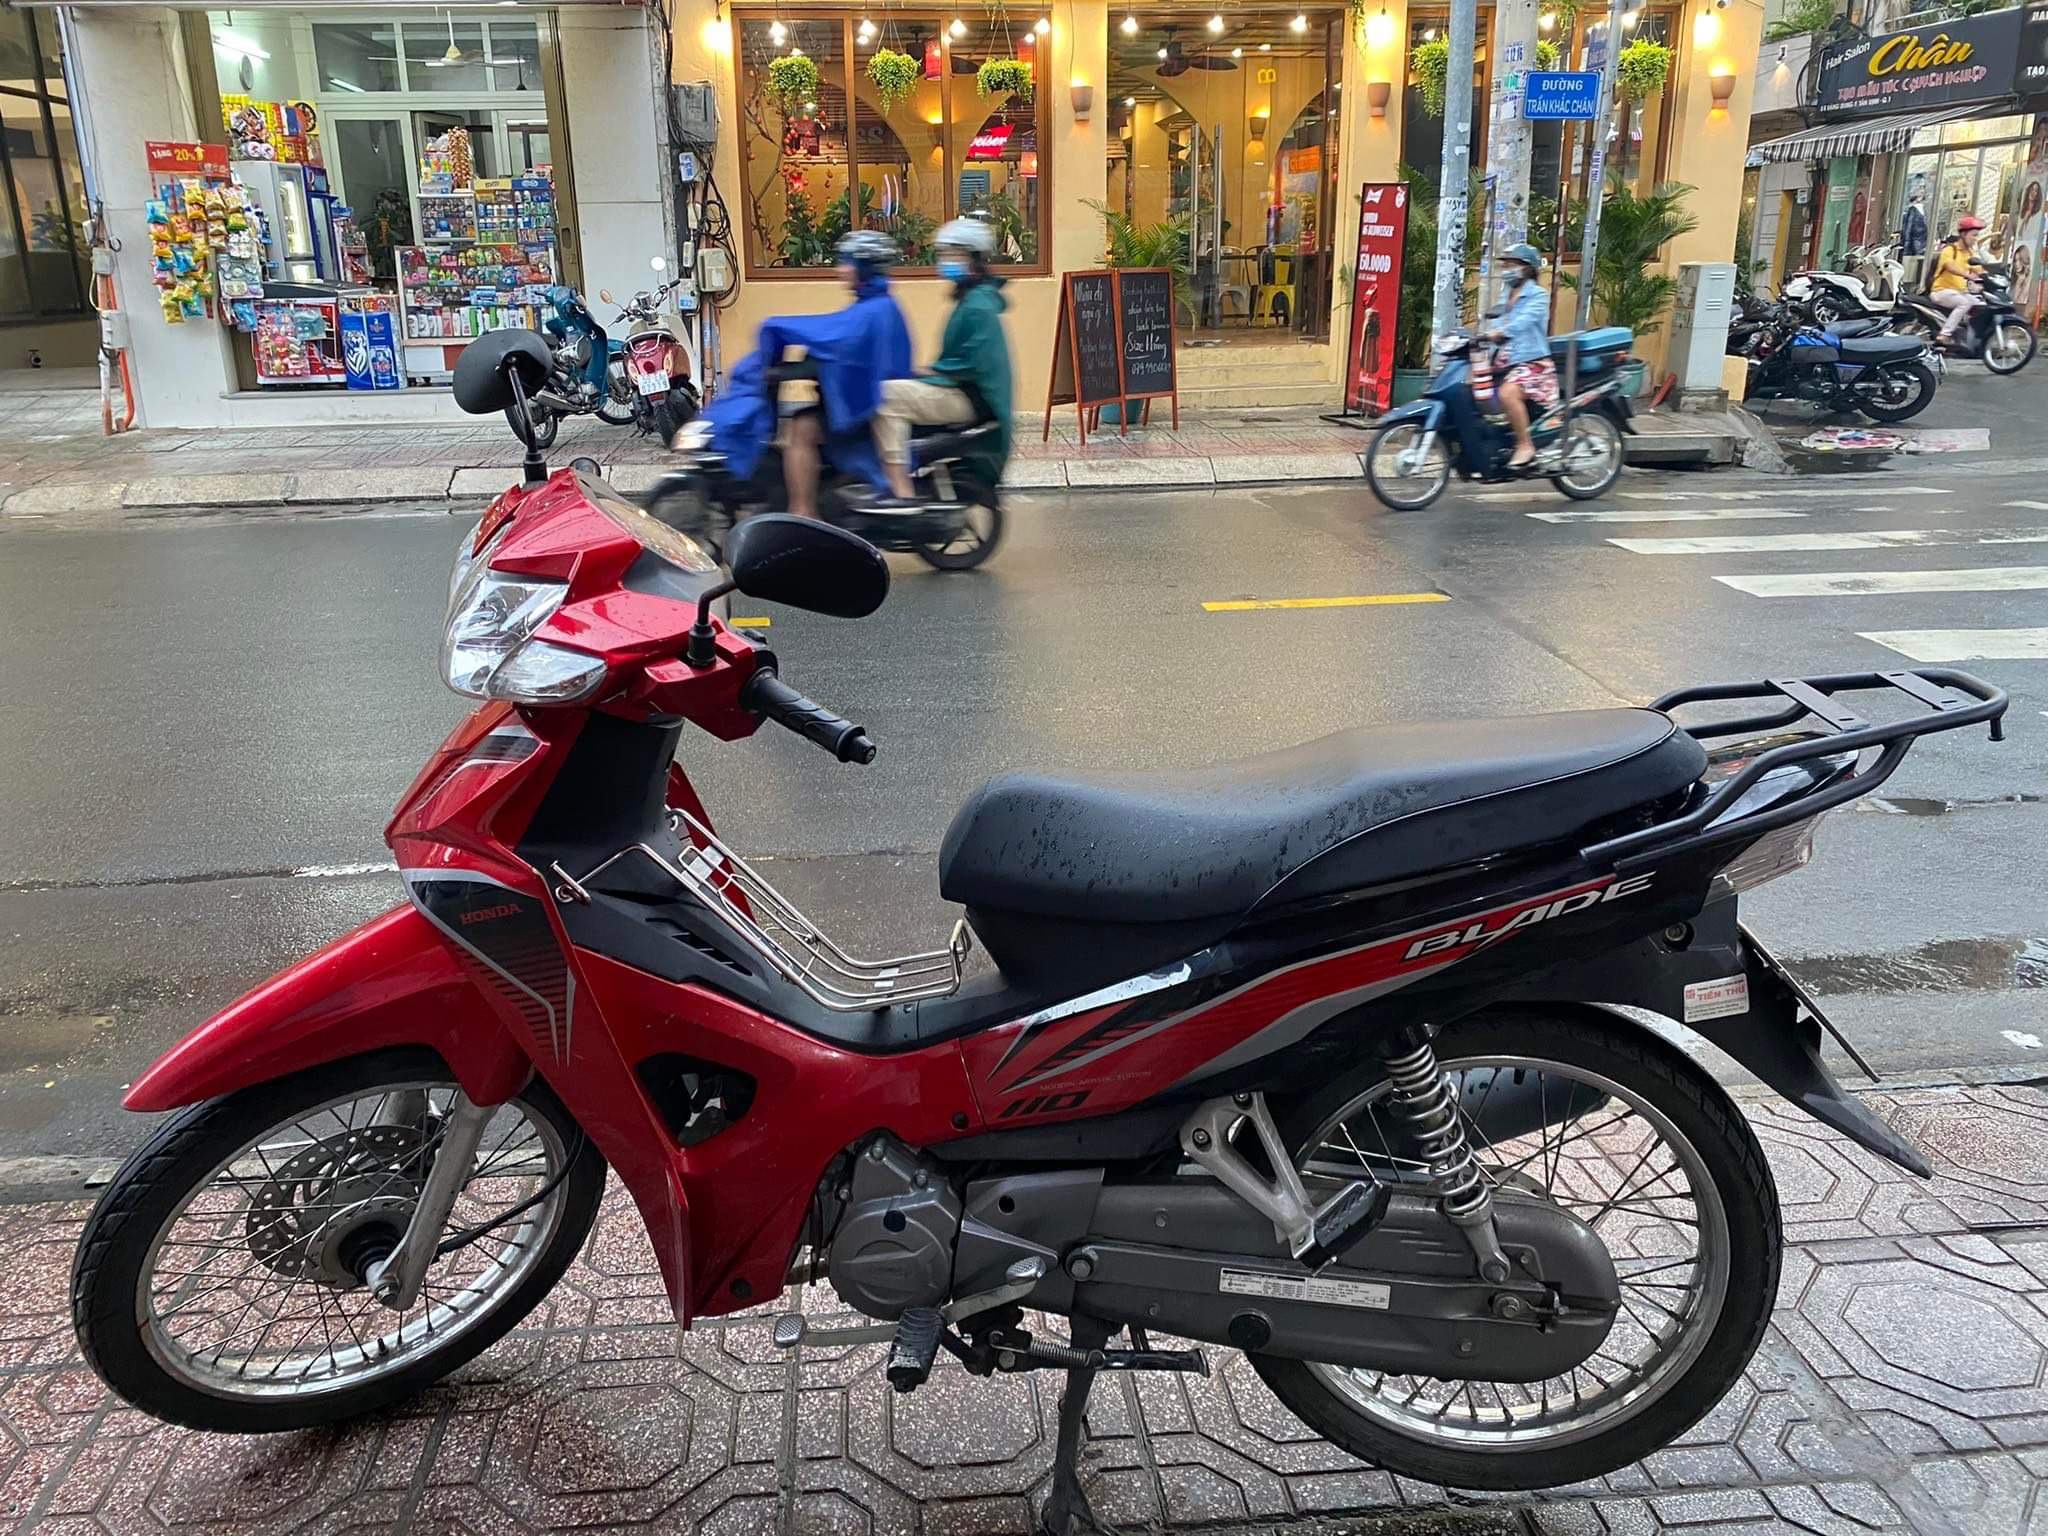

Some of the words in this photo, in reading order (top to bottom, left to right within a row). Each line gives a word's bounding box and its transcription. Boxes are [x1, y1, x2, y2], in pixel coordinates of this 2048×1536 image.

[1825, 53, 1844, 70] Hair
[1844, 41, 1871, 61] Salon
[1868, 33, 1974, 77] Châu
[1542, 77, 1584, 91] ĐƯỜNG
[1527, 94, 1548, 114] TRẦN
[1548, 92, 1571, 113] KHẮC
[459, 903, 523, 925] HONDA
[1404, 871, 1658, 961] BLADE
[995, 1090, 1094, 1119] 110
